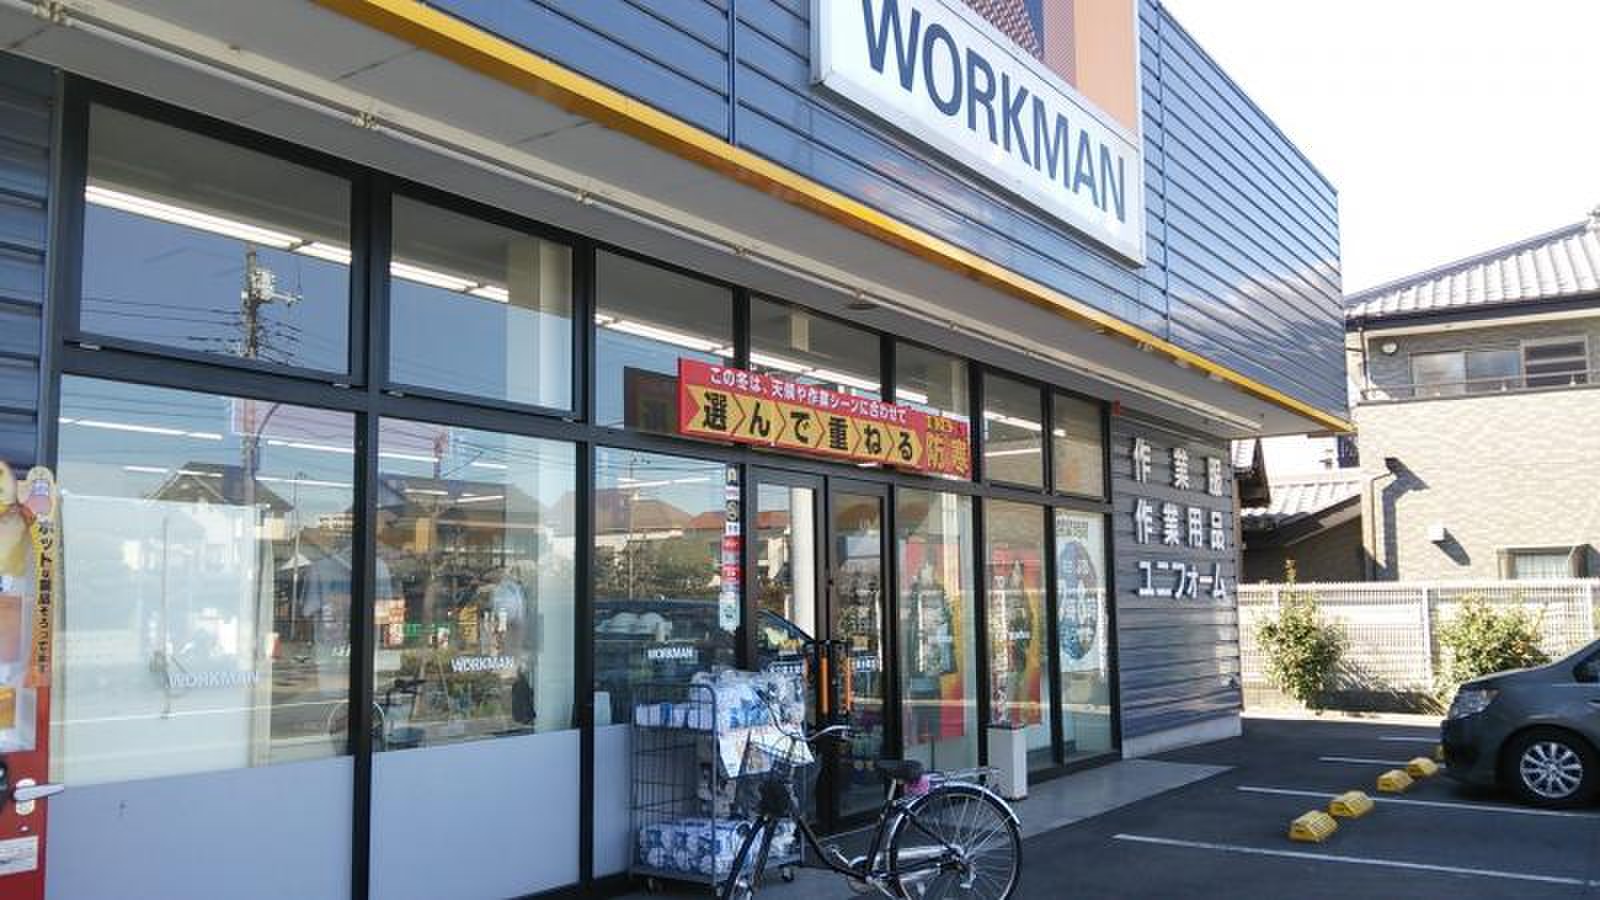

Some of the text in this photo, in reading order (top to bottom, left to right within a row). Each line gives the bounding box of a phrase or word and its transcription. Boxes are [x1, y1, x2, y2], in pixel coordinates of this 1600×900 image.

[862, 0, 1126, 222] WORKMAN
[703, 391, 913, 460] 選んで重ねる
[1135, 498, 1225, 550] 作業用品
[1138, 560, 1226, 600] ユニフォーム
[451, 656, 514, 673] WORKMAN
